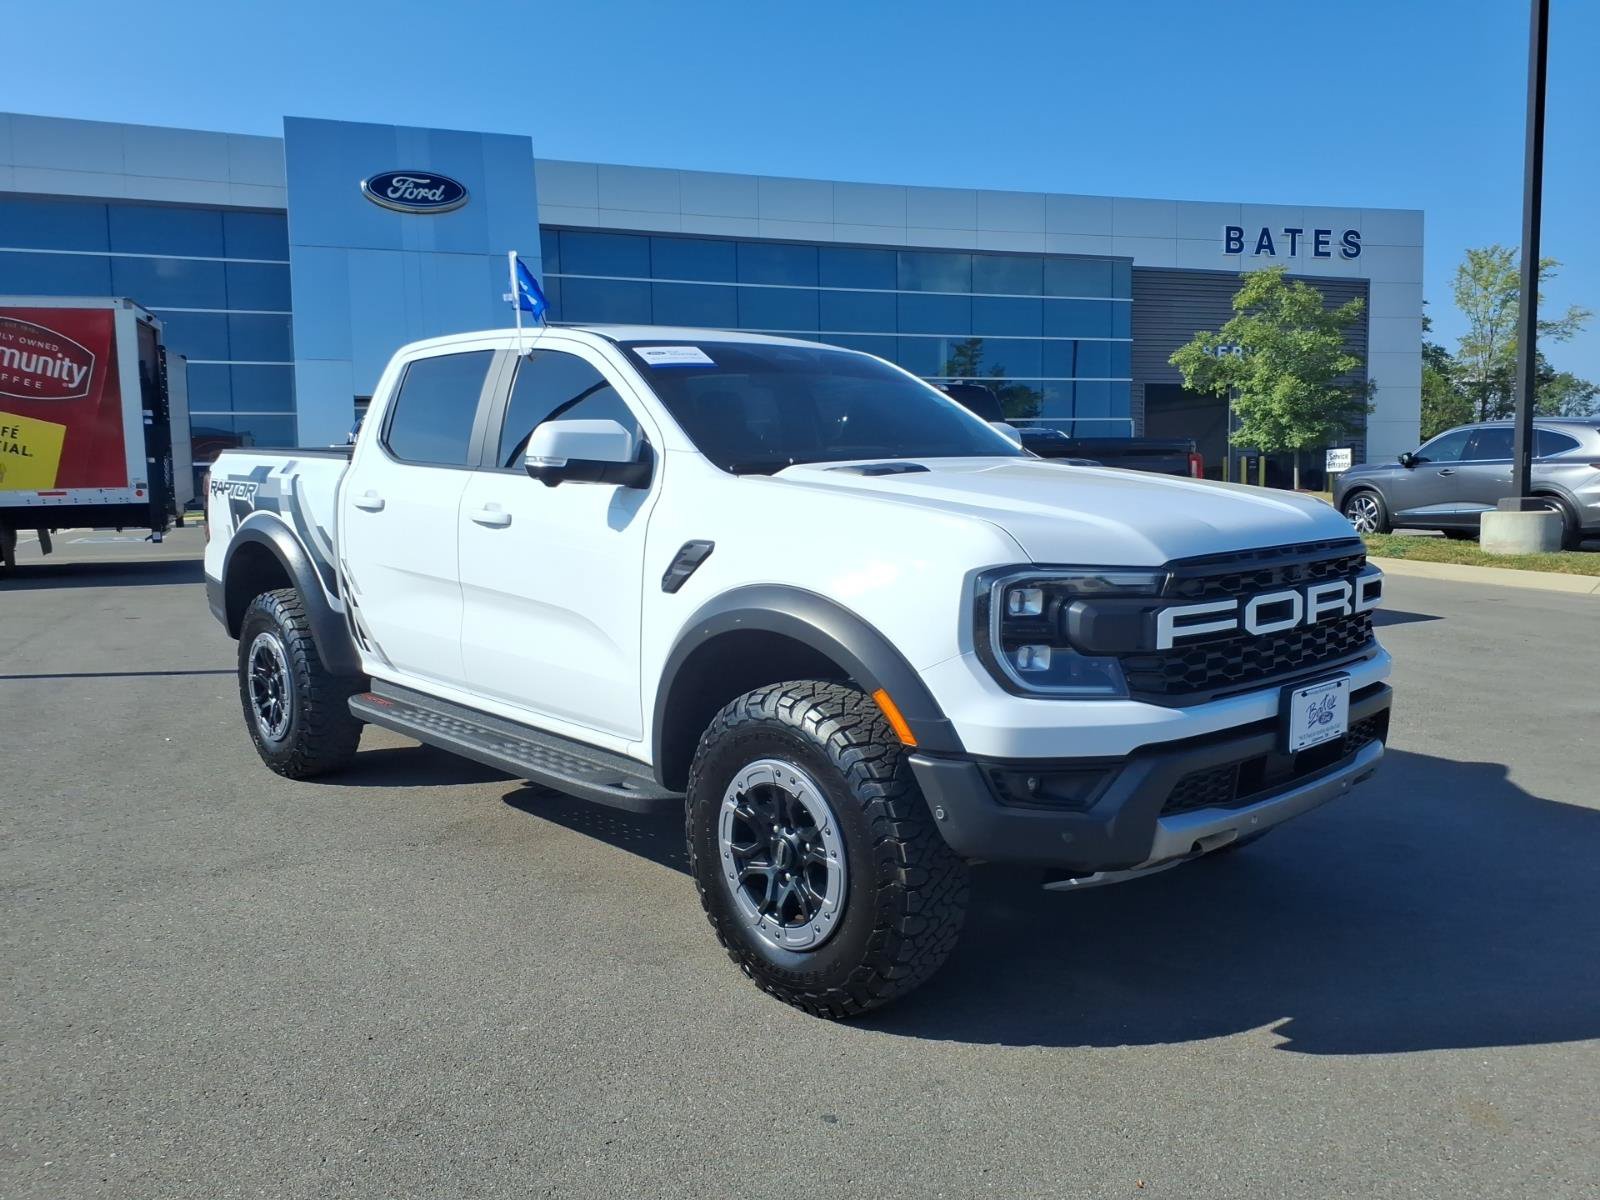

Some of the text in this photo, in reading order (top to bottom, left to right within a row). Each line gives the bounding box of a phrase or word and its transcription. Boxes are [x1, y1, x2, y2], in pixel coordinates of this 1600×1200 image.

[387, 176, 445, 201] Ford
[1224, 225, 1362, 259] BATES
[19, 337, 59, 352] OWNED
[210, 480, 257, 503] RAPTOR
[1156, 574, 1384, 650] FORD
